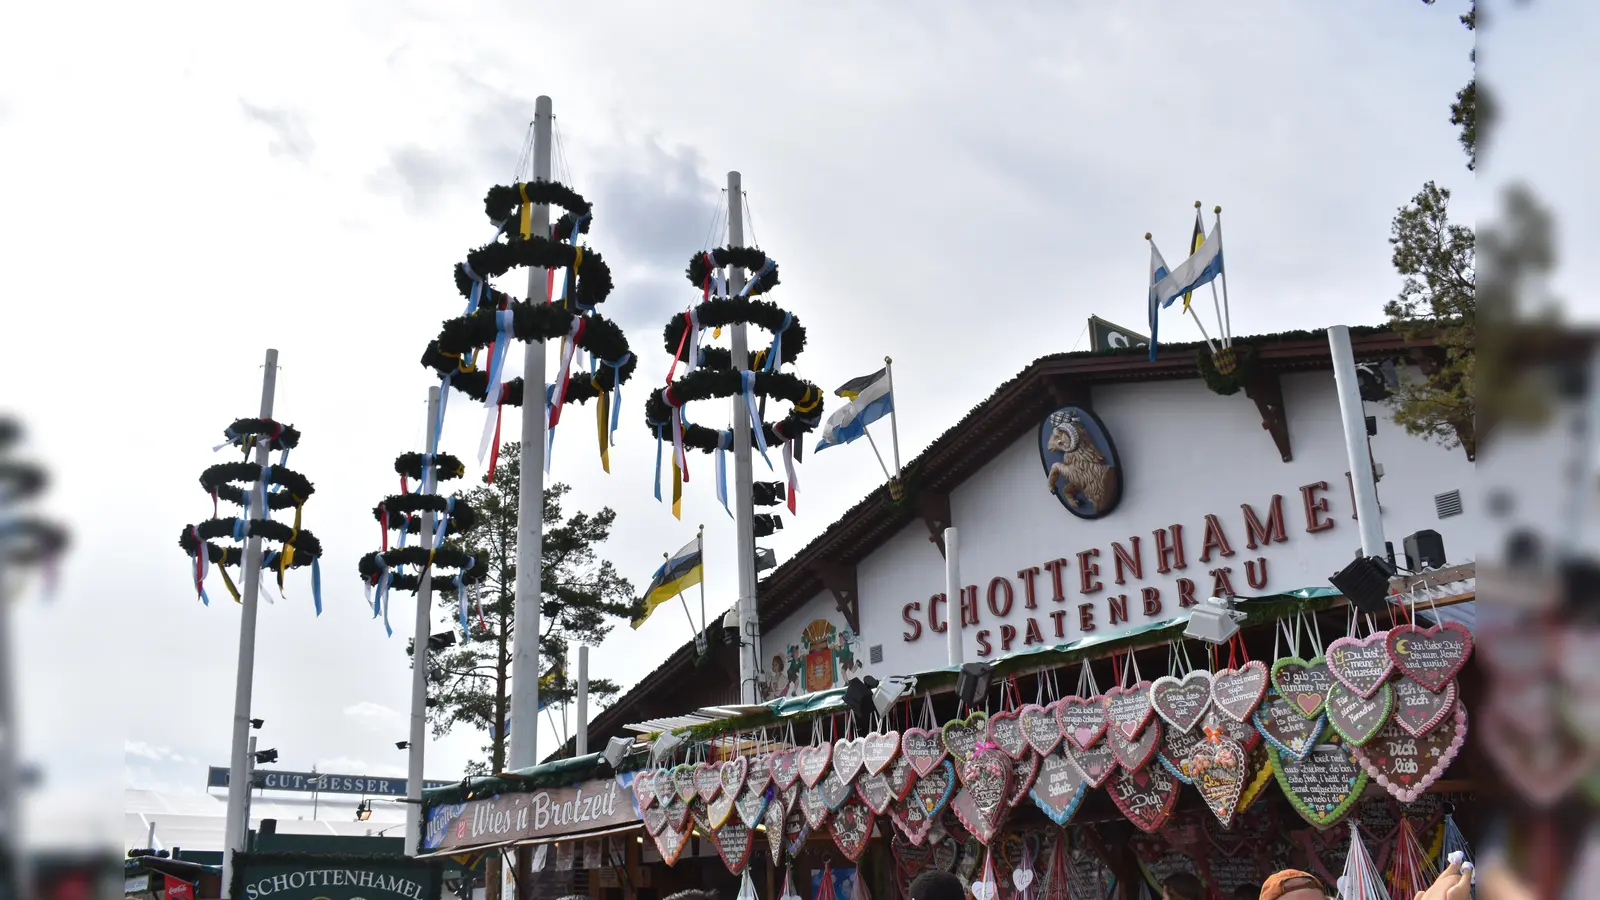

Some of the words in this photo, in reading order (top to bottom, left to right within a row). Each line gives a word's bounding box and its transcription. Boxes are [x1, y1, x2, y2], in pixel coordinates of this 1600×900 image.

[976, 557, 1268, 657] SPATENBRÄU
[1425, 639, 1443, 650] liebe
[1443, 640, 1462, 650] Dich
[1344, 651, 1362, 660] Du
[1363, 648, 1381, 659] bist
[1409, 651, 1422, 660] bis
[1350, 660, 1374, 669] meine
[1405, 660, 1423, 669] und
[1292, 670, 1310, 684] gib
[1310, 671, 1326, 682] Di
[1281, 683, 1314, 693] nimmer
[1315, 681, 1331, 692] her
[1405, 694, 1430, 706] Dich
[1386, 740, 1418, 756] Dich
[1391, 757, 1419, 775] lieb
[265, 774, 308, 790] GUT,
[318, 777, 395, 794] BESSER,
[1050, 771, 1068, 783] mein
[1117, 783, 1137, 800] Ich
[531, 780, 617, 831] Brotzeit
[1130, 791, 1162, 812] Dich
[246, 869, 424, 900] SCHOTTENHAMEL
